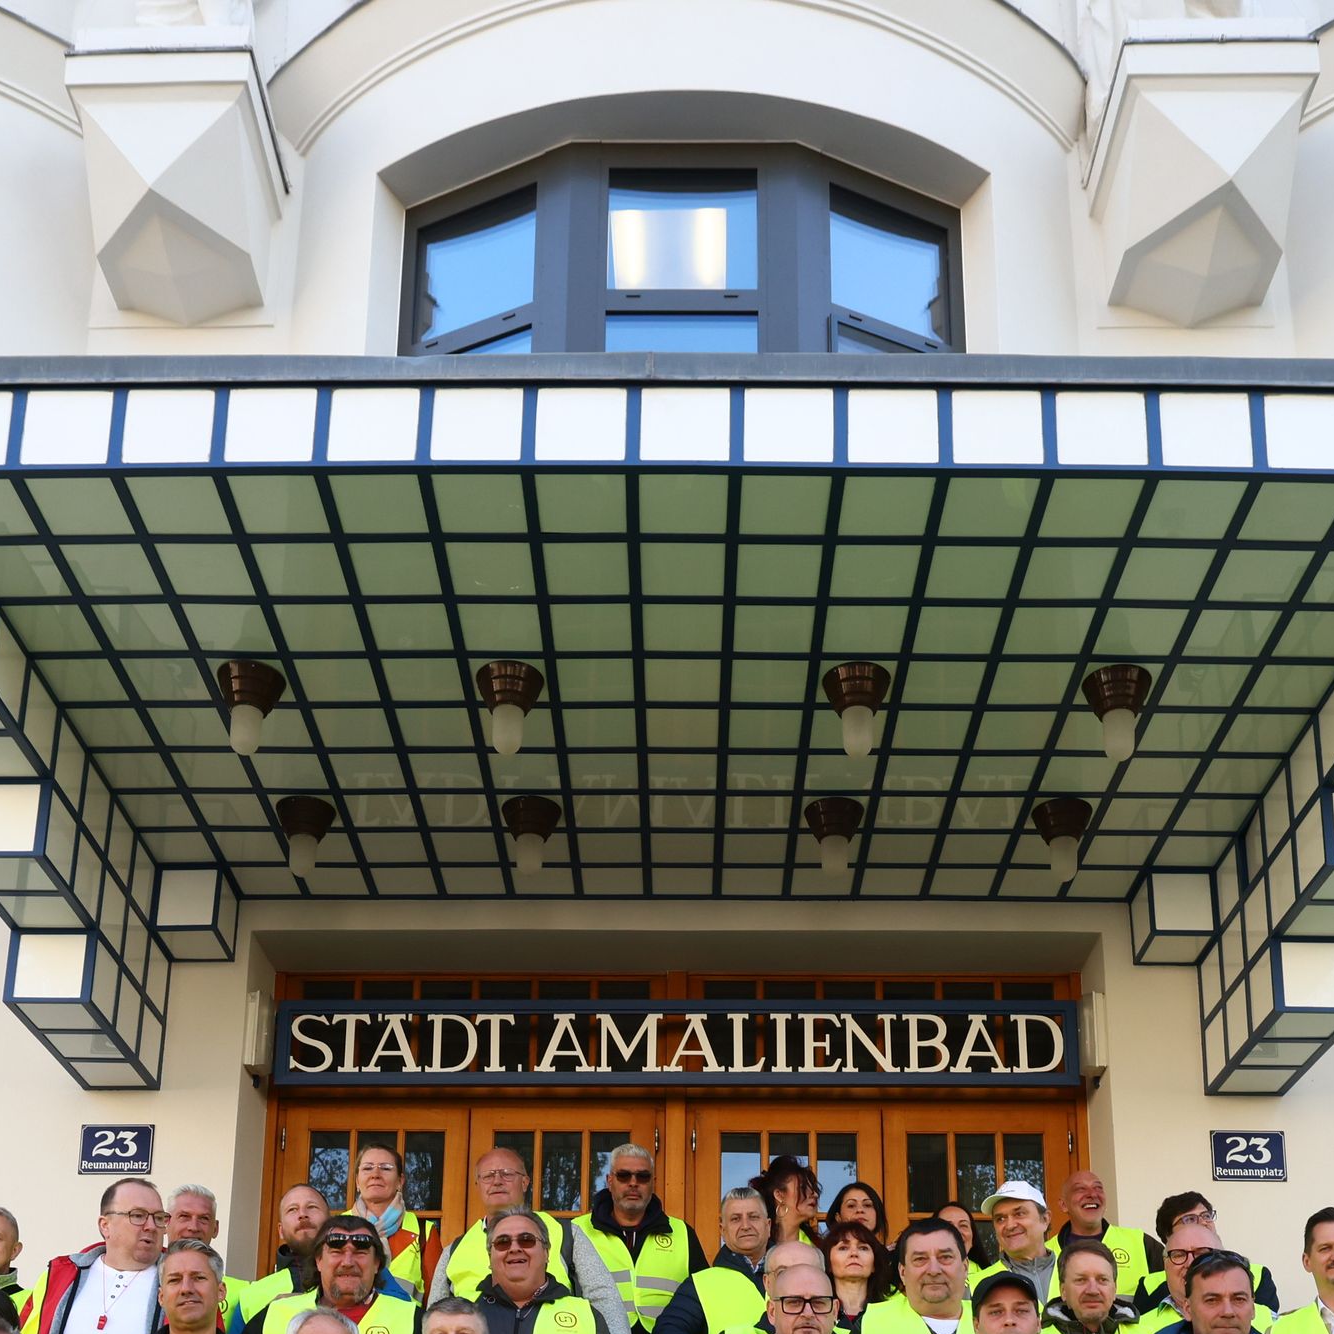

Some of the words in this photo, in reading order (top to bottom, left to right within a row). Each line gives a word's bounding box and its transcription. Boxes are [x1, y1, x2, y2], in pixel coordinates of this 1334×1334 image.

[533, 1013, 1064, 1073] AMALIENBAD
[92, 1130, 138, 1157] 23
[1226, 1136, 1272, 1164] 23
[81, 1160, 148, 1171] Reumannplatz
[1216, 1167, 1284, 1178] Reumannplatz
